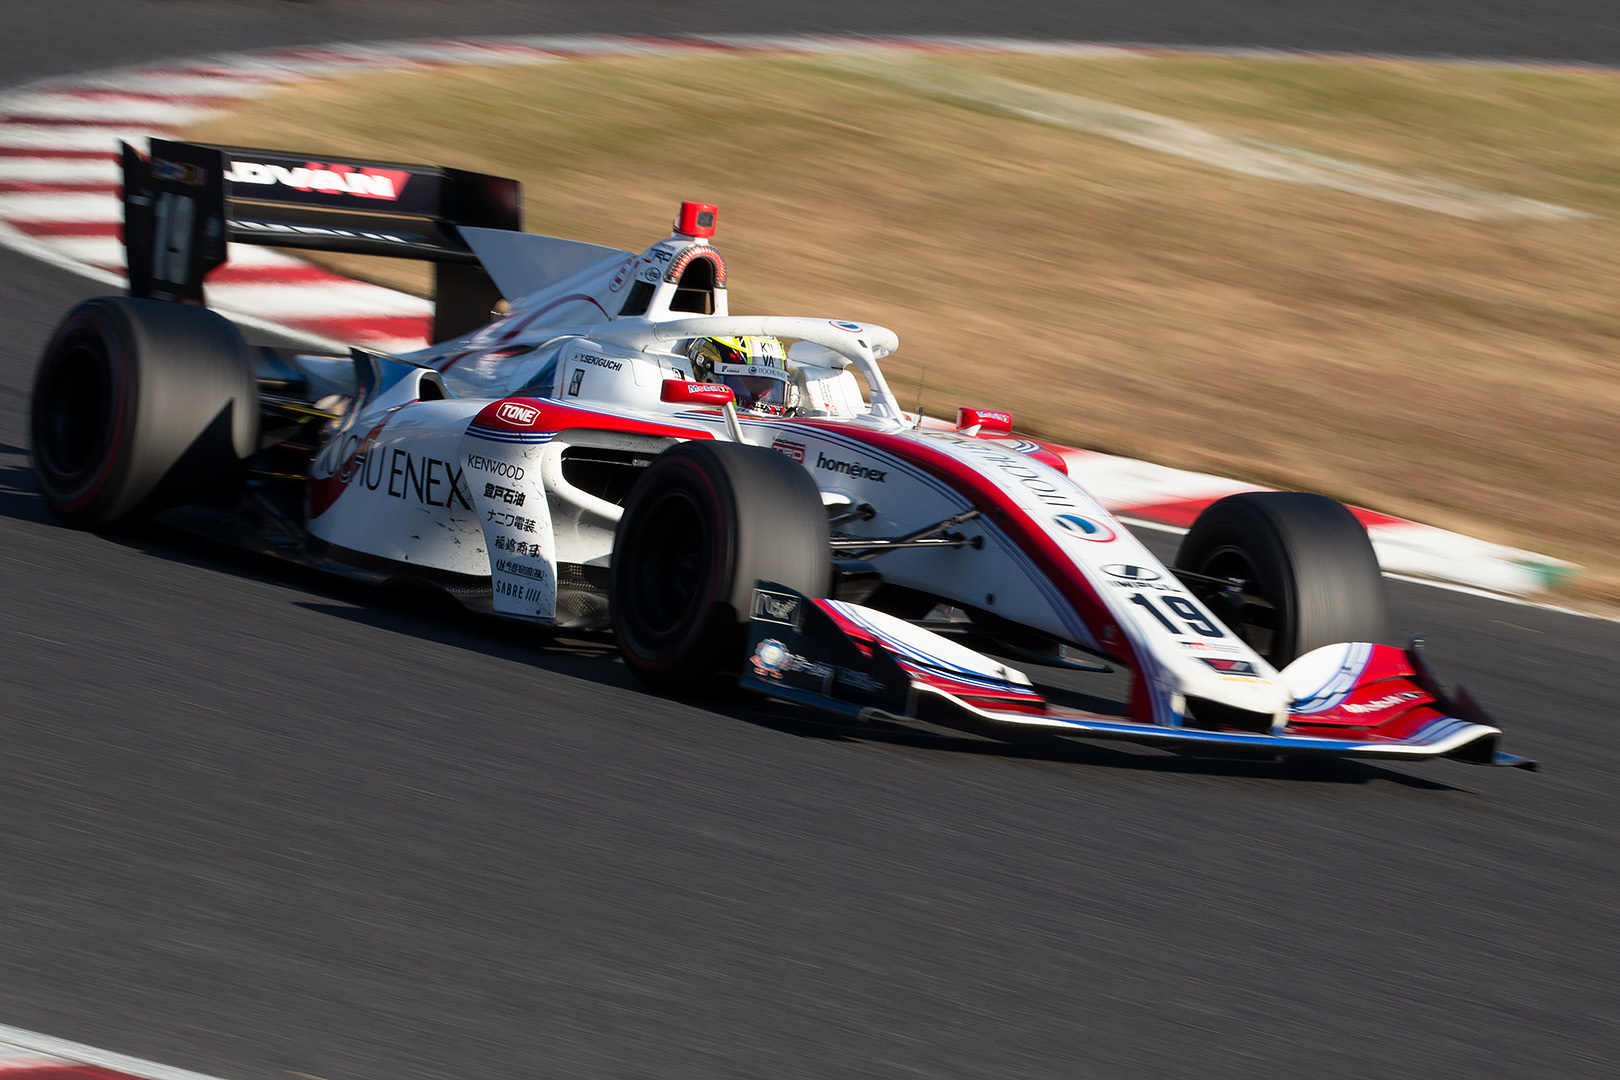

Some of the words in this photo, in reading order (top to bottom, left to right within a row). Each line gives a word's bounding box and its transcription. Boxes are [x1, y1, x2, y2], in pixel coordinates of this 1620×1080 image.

[501, 404, 536, 423] TONE
[468, 453, 525, 480] KENWOOD
[388, 448, 472, 511] ENEX
[483, 482, 527, 507] 登戸石油
[487, 509, 538, 534] ナニワ電装
[496, 580, 525, 600] SABRE
[1127, 592, 1225, 638] 19
